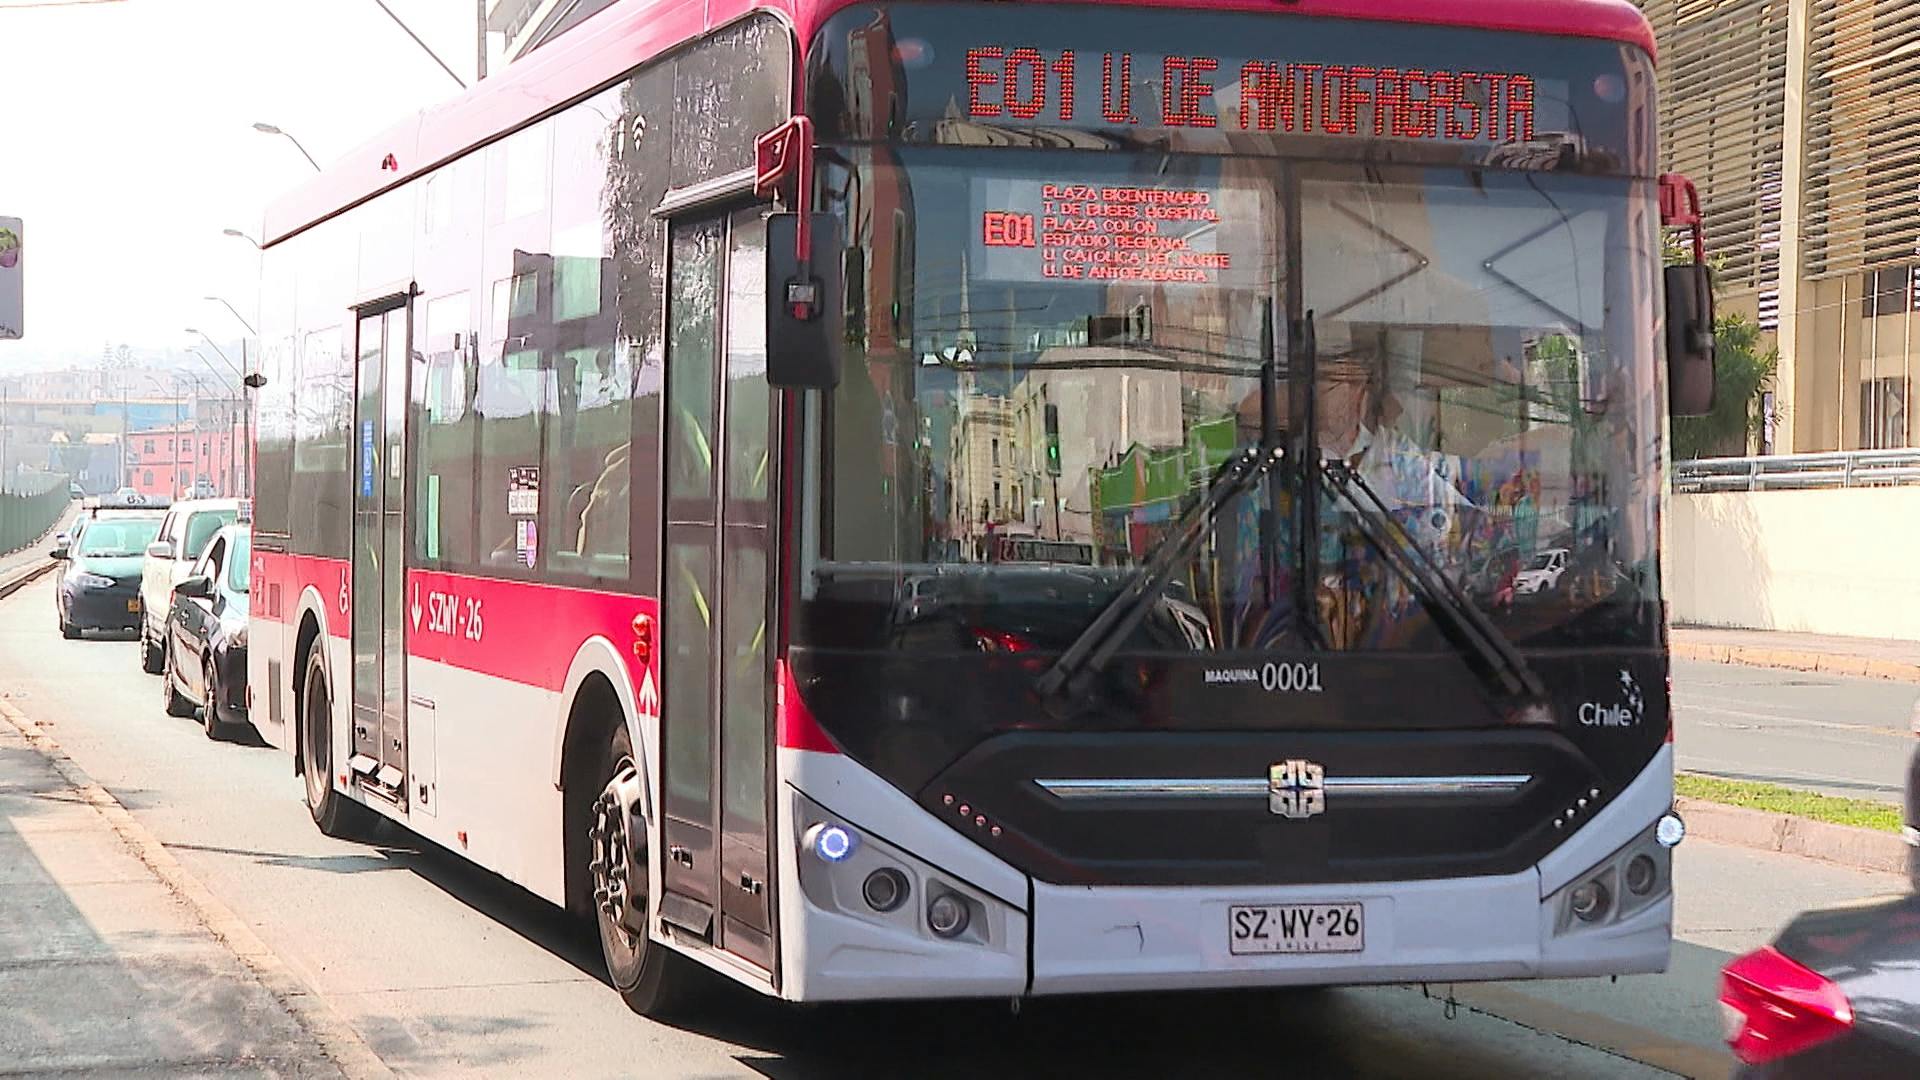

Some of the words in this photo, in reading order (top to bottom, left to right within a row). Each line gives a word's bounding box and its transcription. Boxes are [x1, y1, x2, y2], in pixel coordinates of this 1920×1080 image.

[966, 47, 1074, 120] E01
[1102, 53, 1137, 123] U.
[1163, 56, 1217, 127] DE
[1240, 60, 1534, 142] ANTOFAGASTA
[1042, 185, 1098, 201] PLAZA
[1102, 188, 1211, 206] BICENTENARIO
[1060, 203, 1080, 216] DE
[1145, 207, 1221, 223] HOSPITAL
[984, 211, 1036, 248] E01
[1042, 217, 1098, 232] PLAZA
[1102, 218, 1158, 234] COLON
[1042, 233, 1110, 248] ESTADIO
[1114, 235, 1192, 251] REGIONAL
[1062, 249, 1142, 265] CATOLICA
[1178, 254, 1231, 269] NORTE
[1062, 265, 1083, 279] DE
[1087, 266, 1208, 283] ANTOFAGASTA
[1205, 669, 1258, 682] MAQUINA
[1262, 662, 1322, 691] 0001
[1578, 702, 1633, 726] Chile
